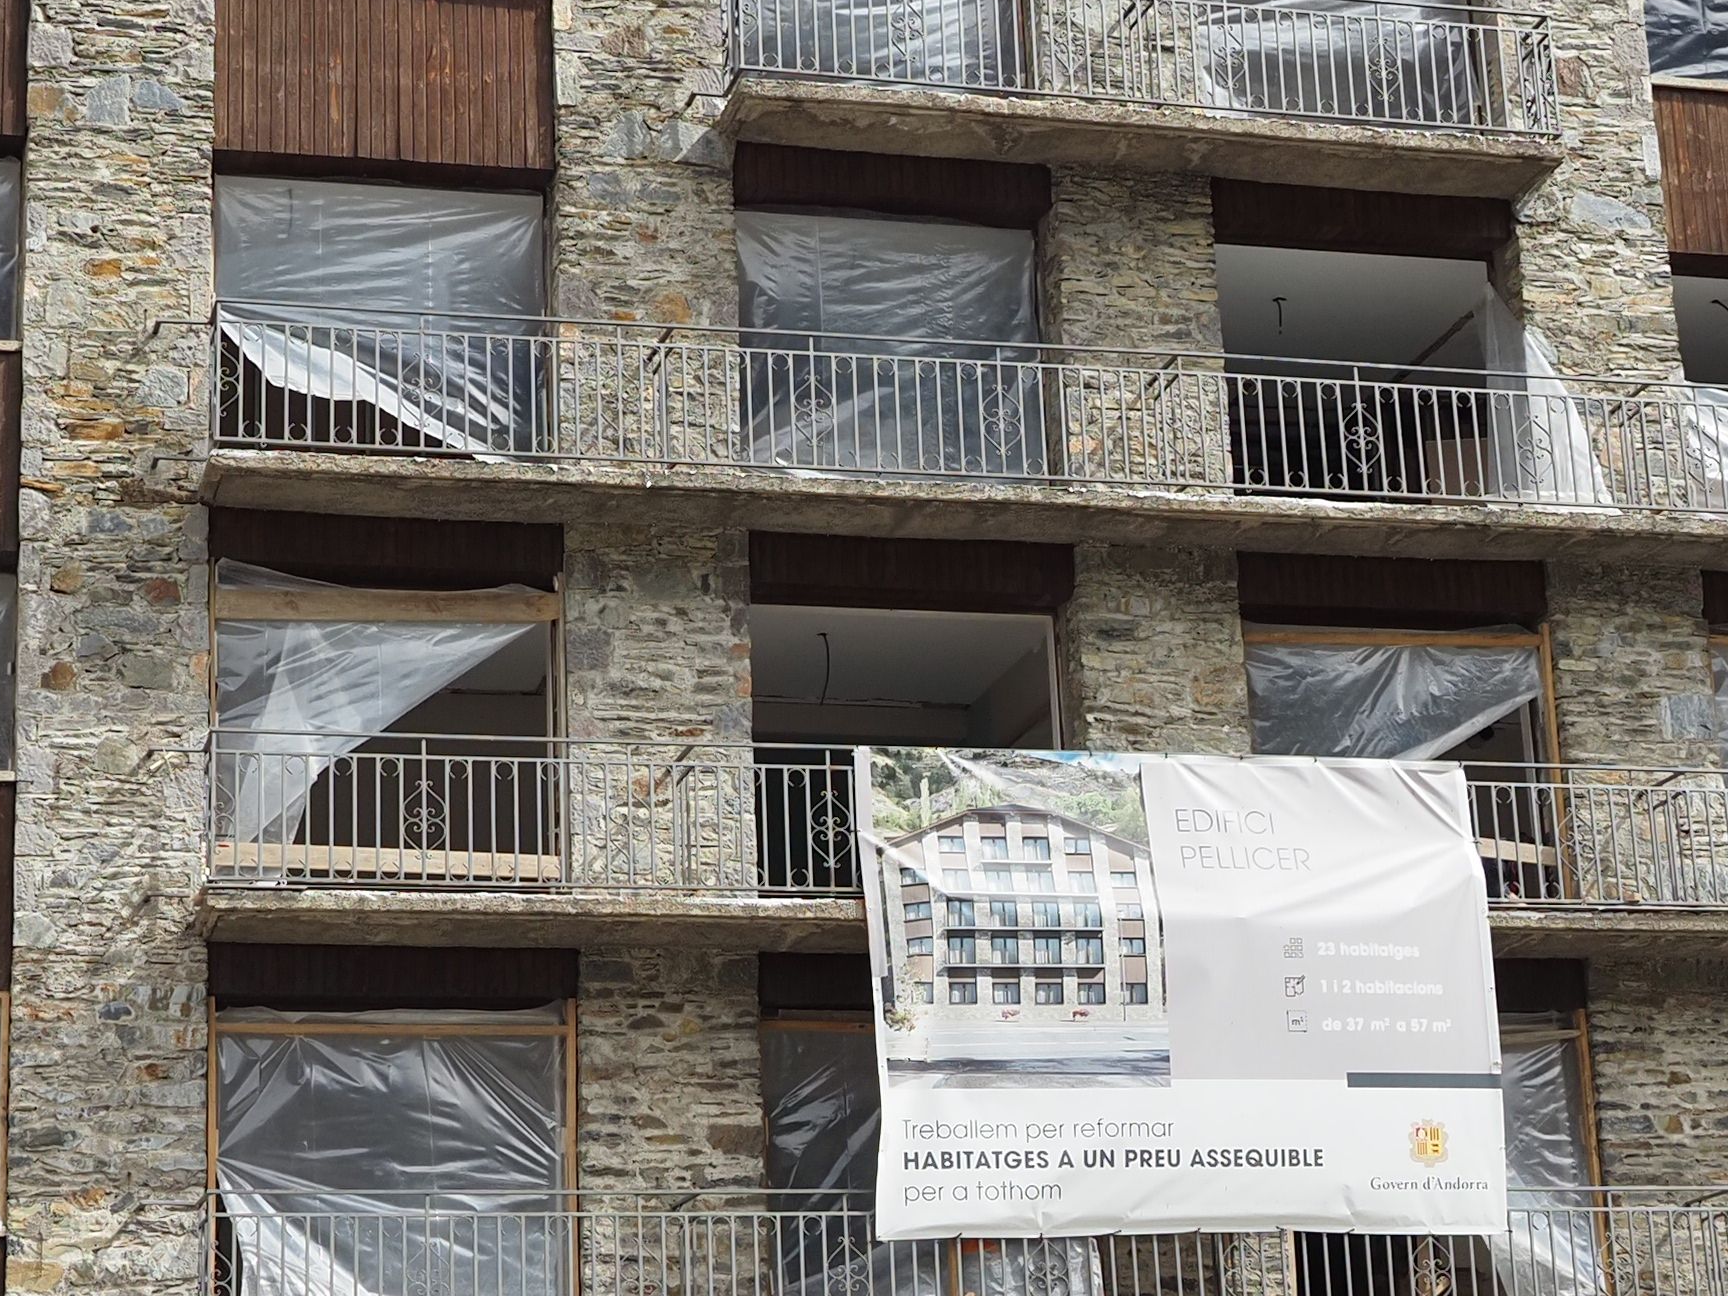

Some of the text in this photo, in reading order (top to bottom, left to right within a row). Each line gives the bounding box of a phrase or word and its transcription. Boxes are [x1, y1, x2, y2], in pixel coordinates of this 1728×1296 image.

[1174, 807, 1275, 835] EDIFICI
[1179, 844, 1312, 872] PELLICER
[1316, 941, 1421, 961] 23 habitatges
[1320, 979, 1444, 996] 1 i 2 habitacions
[1321, 1017, 1342, 1032] de
[1345, 1017, 1365, 1033] 37
[1395, 1020, 1407, 1033] a
[1410, 1018, 1429, 1033] 57
[902, 1117, 1175, 1144] Treballem per reformar
[903, 1148, 1324, 1171] HABITATGES A UN PREU ASSEQUIBLE
[904, 1180, 1063, 1207] per a tothom
[1370, 1175, 1489, 1191] Govern d'Andorra
